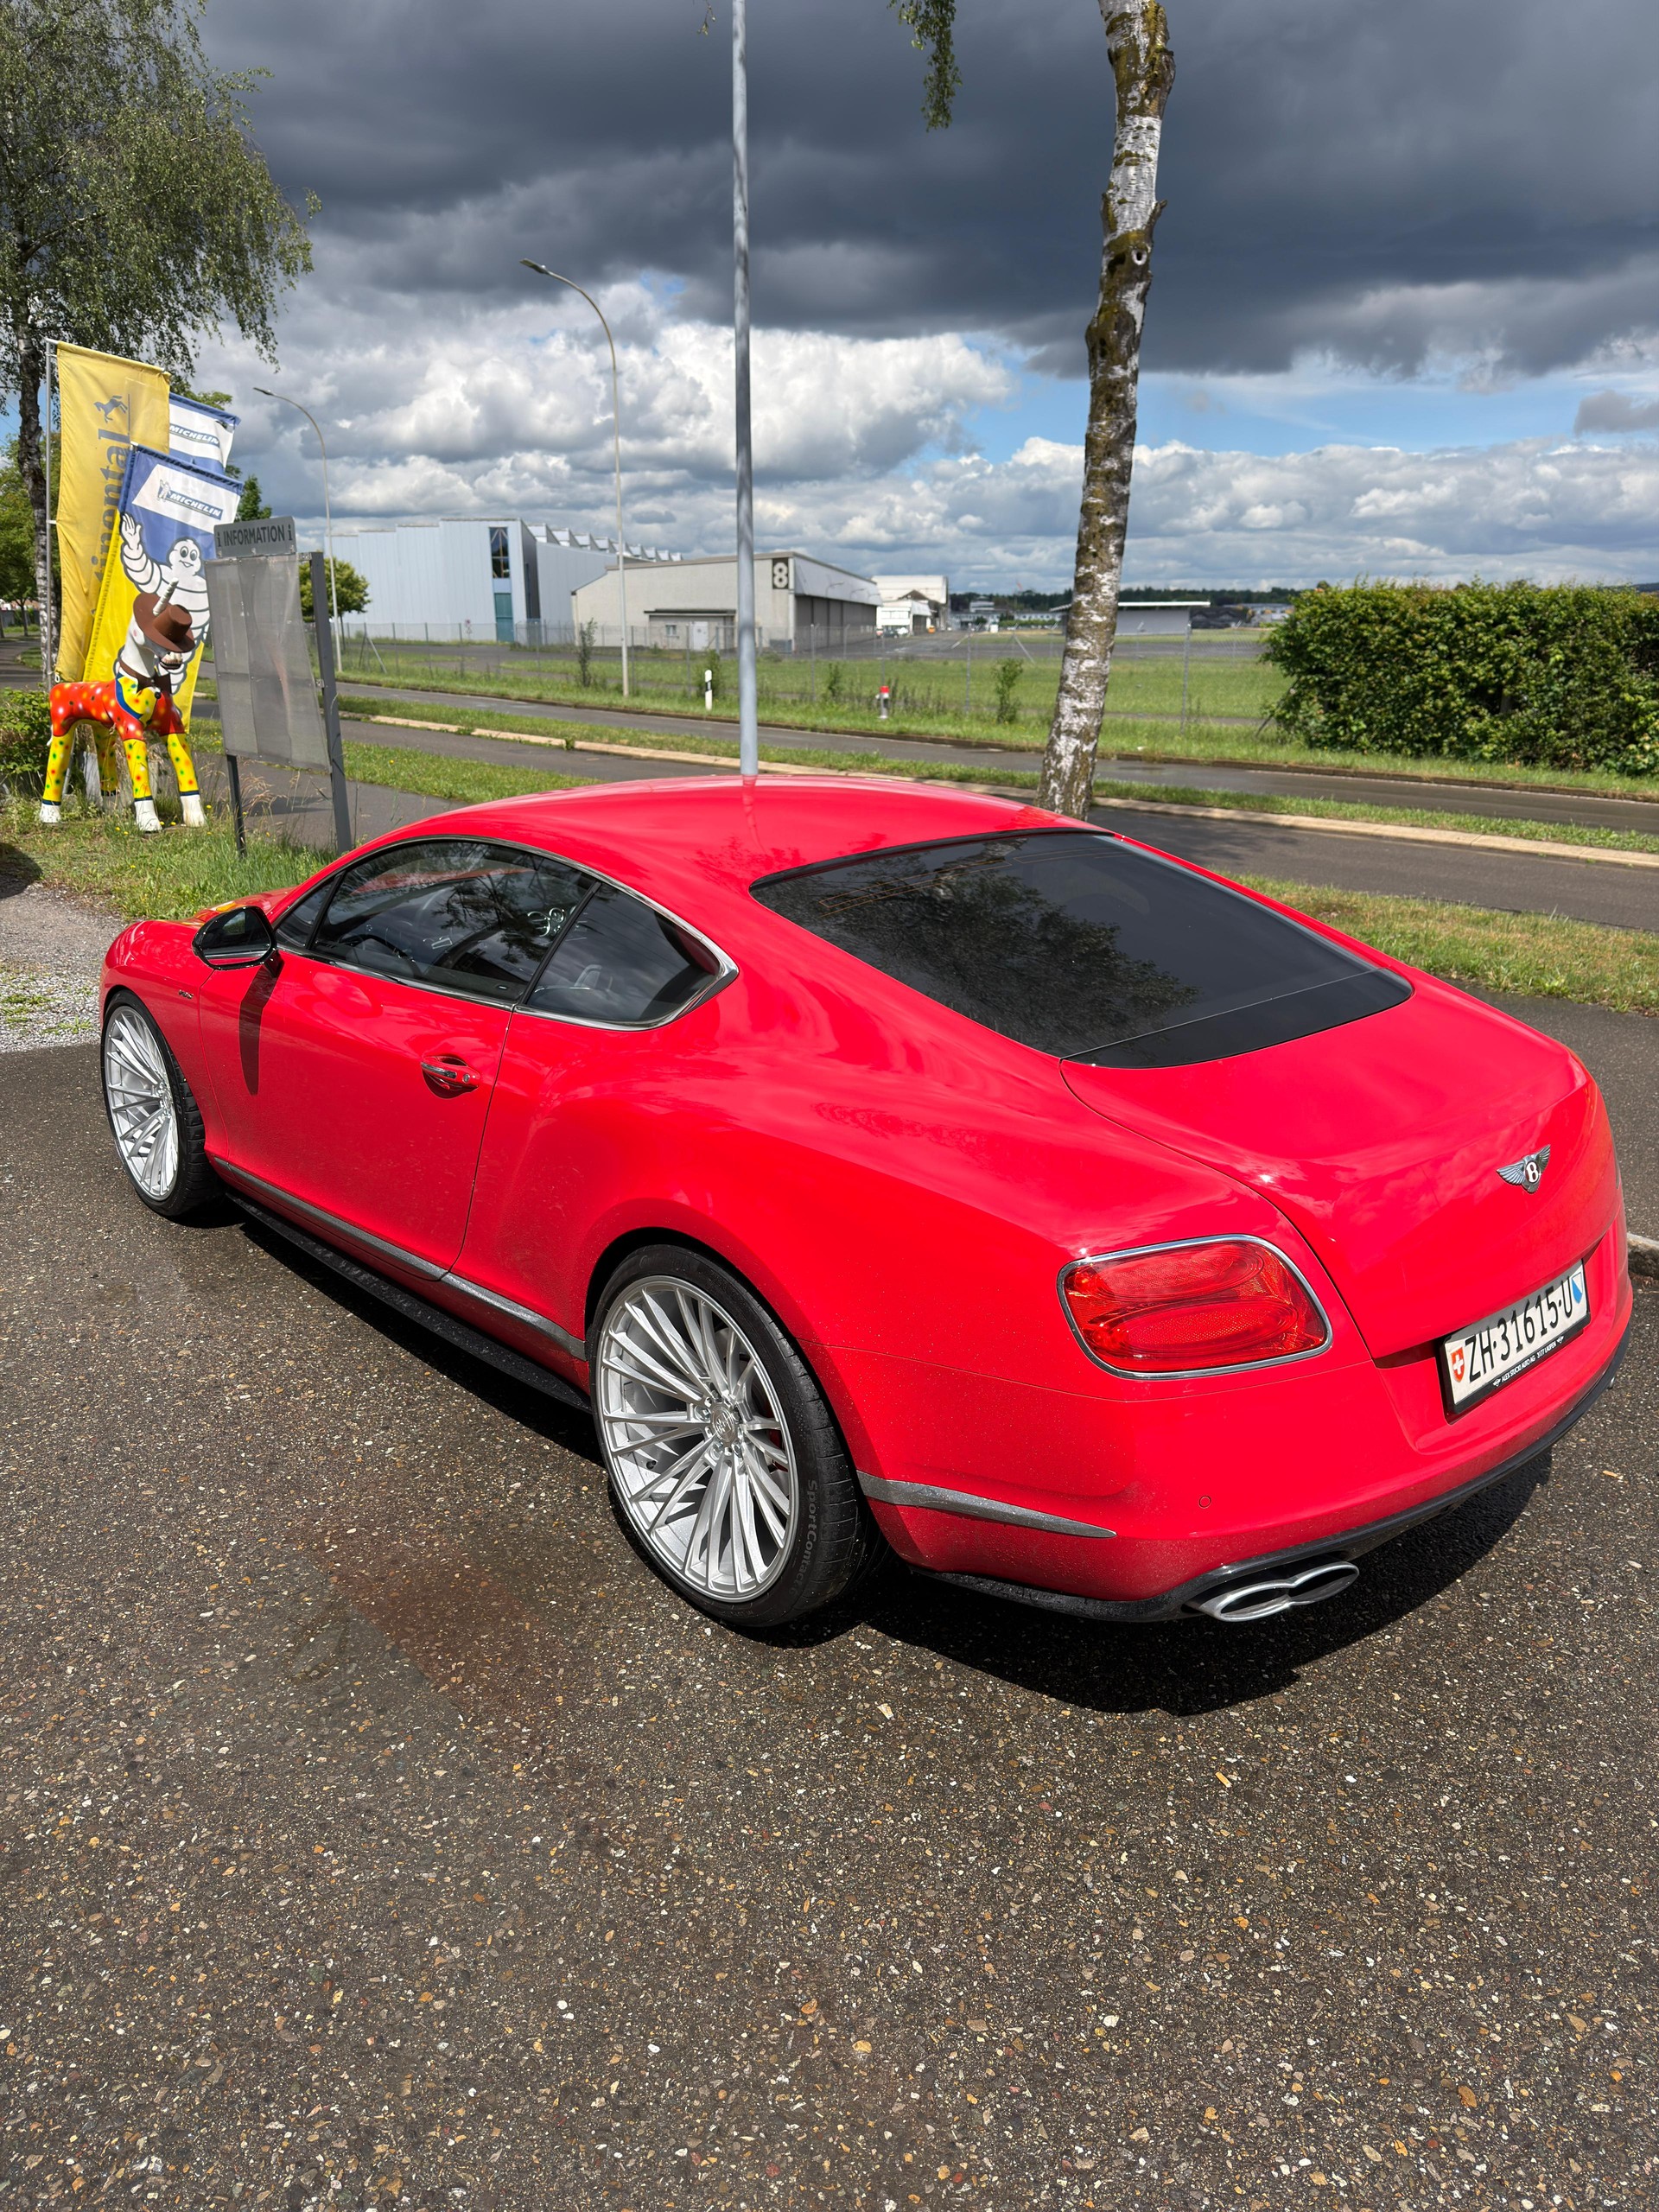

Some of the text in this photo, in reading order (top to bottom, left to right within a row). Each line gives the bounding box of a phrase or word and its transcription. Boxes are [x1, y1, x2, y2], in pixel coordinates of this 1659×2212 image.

[169, 424, 219, 445] MICHELIN
[169, 492, 221, 518] MICHELIN
[223, 524, 285, 547] INFORMATION
[773, 562, 788, 588] 8
